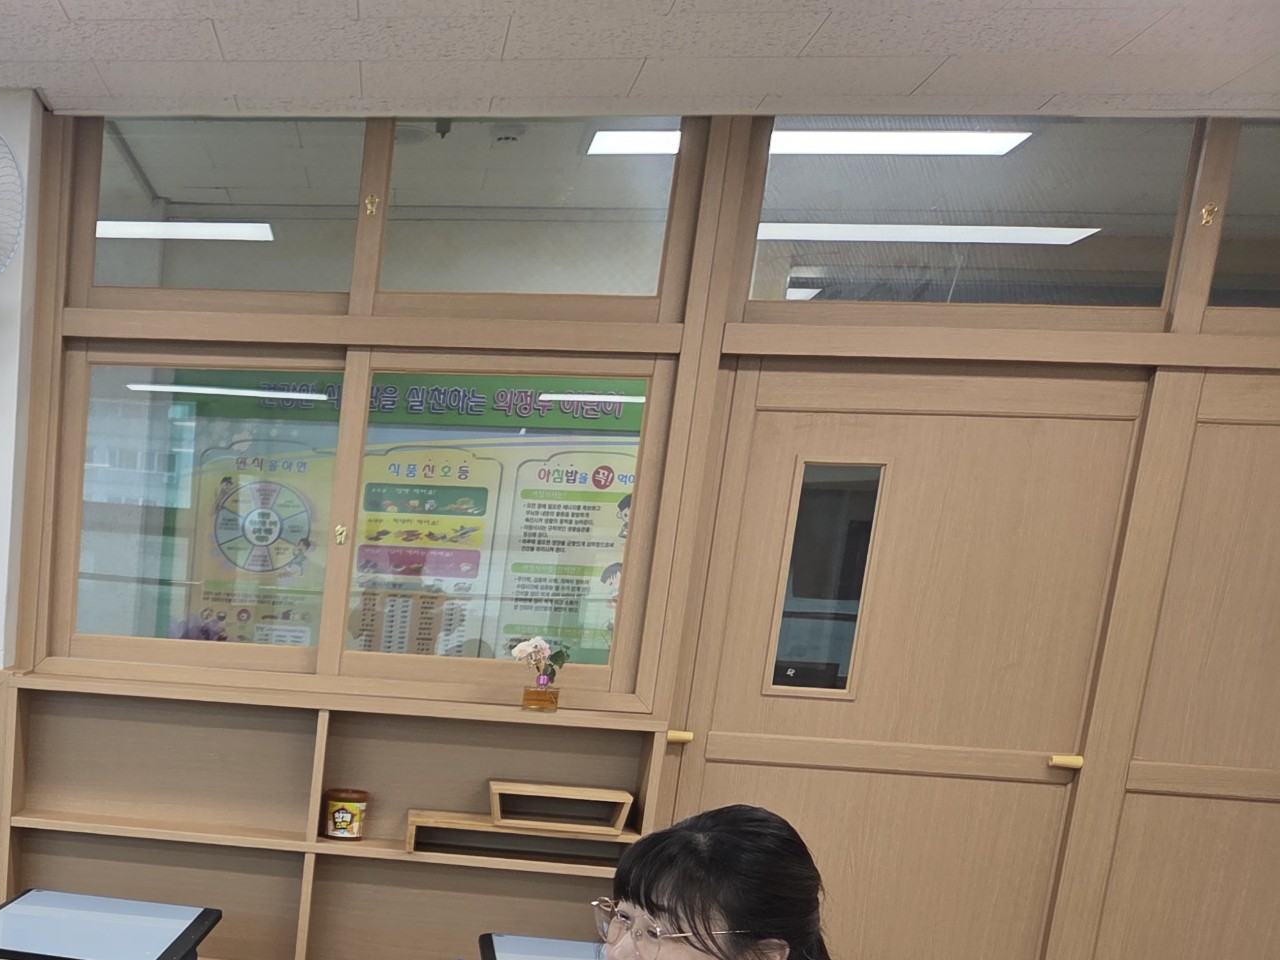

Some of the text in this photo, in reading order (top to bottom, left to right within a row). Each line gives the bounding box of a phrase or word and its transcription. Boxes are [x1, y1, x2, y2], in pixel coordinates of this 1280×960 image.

[406, 385, 487, 416] 실천하는
[494, 388, 556, 418] 의정부
[537, 468, 588, 485] 아침밥을
